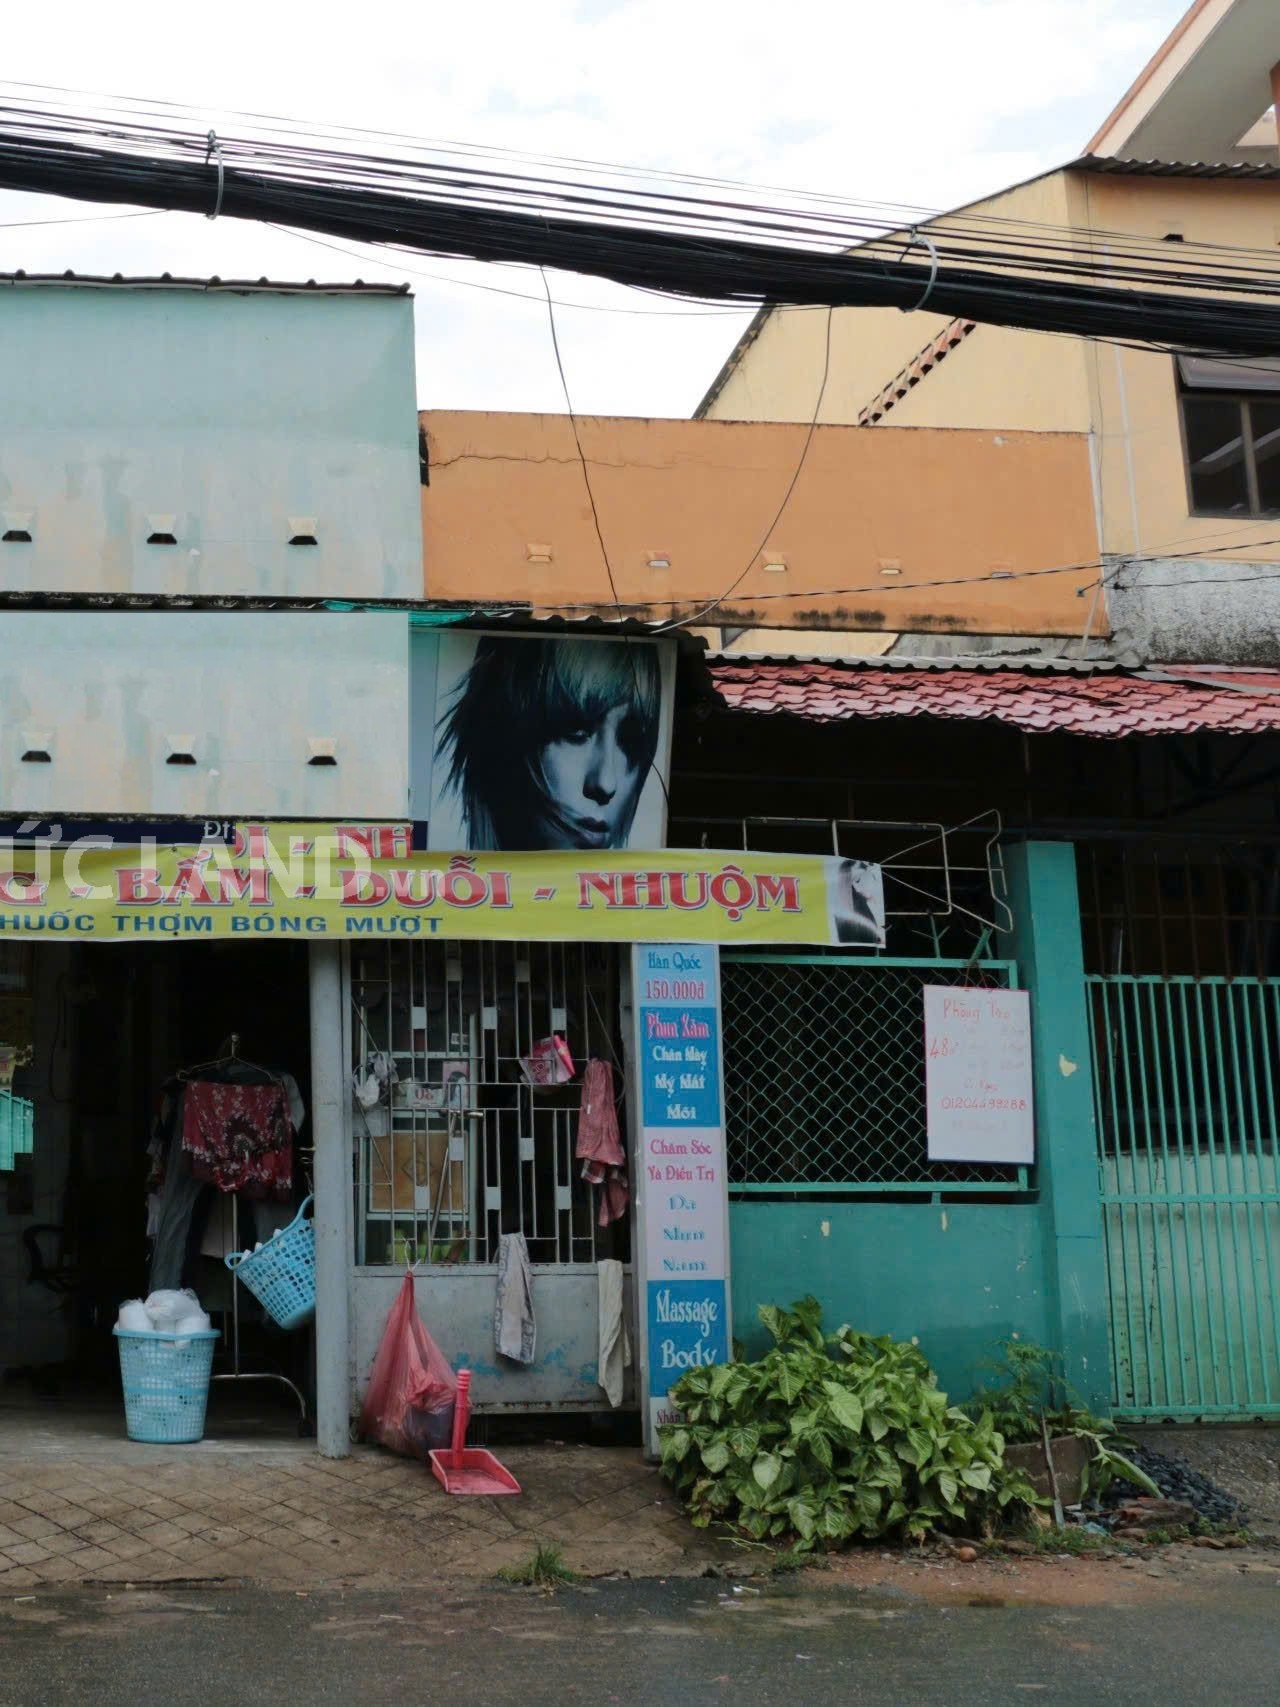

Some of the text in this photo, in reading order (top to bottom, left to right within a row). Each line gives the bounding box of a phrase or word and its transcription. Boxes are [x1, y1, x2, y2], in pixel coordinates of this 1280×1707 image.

[337, 855, 514, 909] DUỖI
[576, 864, 803, 921] NHUỘM
[231, 912, 328, 933] BÓNG
[646, 1012, 678, 1040] Phun
[656, 1289, 718, 1338] Massage
[661, 1340, 717, 1368] Body
